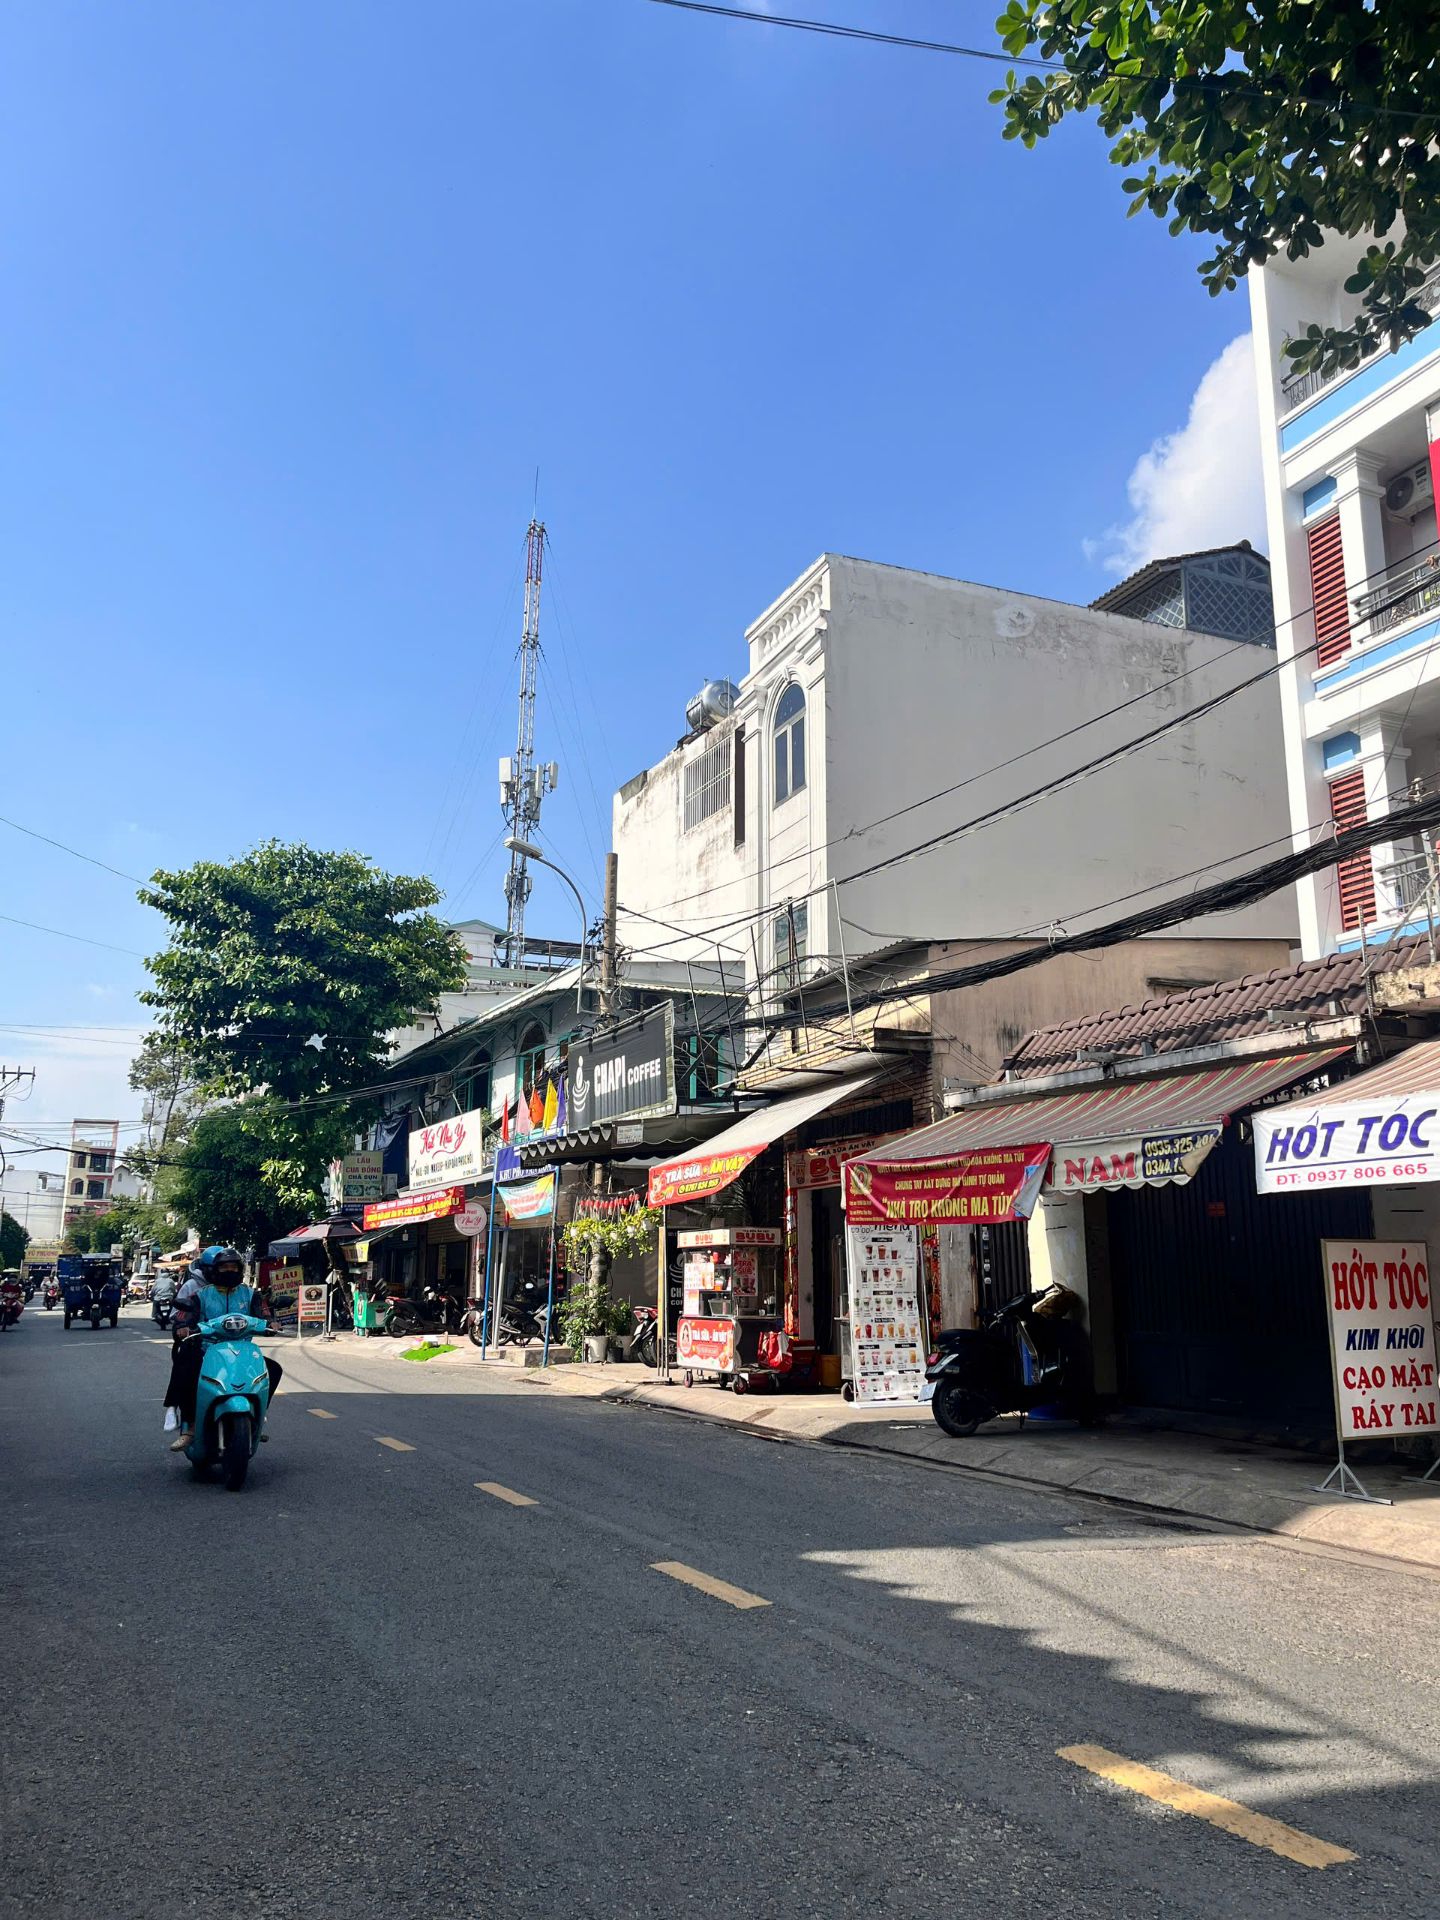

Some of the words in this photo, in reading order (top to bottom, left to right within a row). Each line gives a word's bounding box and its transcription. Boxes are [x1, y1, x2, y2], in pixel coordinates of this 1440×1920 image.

[594, 1055, 626, 1097] CHAPI
[627, 1058, 661, 1085] COFFEE
[1266, 1110, 1345, 1163] HỚT
[1357, 1099, 1437, 1154] TÓC
[984, 1153, 1002, 1163] KHÔNG
[1003, 1154, 1013, 1162] MA
[1014, 1152, 1024, 1162] TÚY
[1064, 1152, 1138, 1185] NAM
[500, 1168, 511, 1181] KHU
[895, 1180, 913, 1191] CHUNG
[978, 1174, 986, 1188] TỰ
[1276, 1173, 1301, 1185] ĐT:
[1308, 1169, 1347, 1182] 0937
[1354, 1166, 1386, 1179] 806
[1393, 1163, 1427, 1176] 665
[909, 1200, 929, 1224] TRỌ
[930, 1195, 968, 1219] KHÔNG
[971, 1197, 988, 1217] MA
[735, 1232, 775, 1241] BUBU
[1332, 1248, 1378, 1310] HỚT
[1384, 1248, 1429, 1310] TÓC
[1345, 1328, 1380, 1351] KIM
[1386, 1323, 1425, 1349] KHÔI
[1343, 1366, 1386, 1396] CẠO
[1391, 1357, 1433, 1393] MẶT
[1352, 1399, 1395, 1429] RÁY
[1401, 1402, 1436, 1426] TAI
